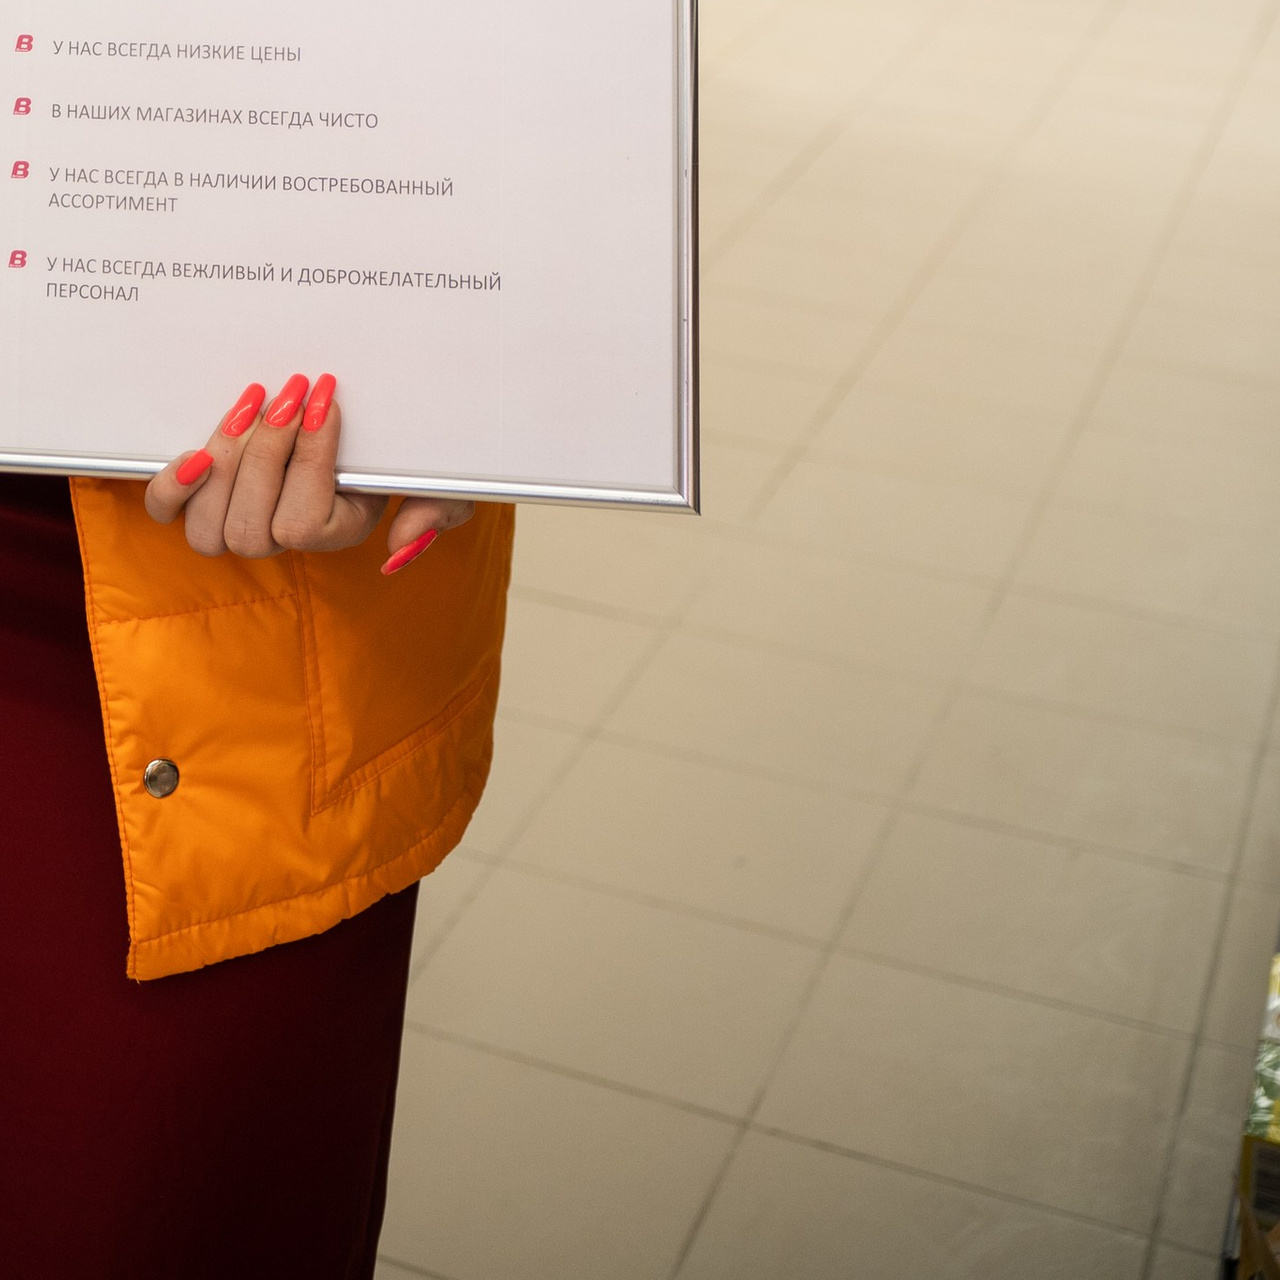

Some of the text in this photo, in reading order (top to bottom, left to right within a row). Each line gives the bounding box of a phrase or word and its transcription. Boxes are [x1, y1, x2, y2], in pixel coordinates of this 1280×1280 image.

[52, 40, 301, 64] У НАС ВСЕГДА НИЗКИЕ ЦЕНЫ
[51, 103, 379, 130] В НАШИХ МАГАЗИНАХ ВСЕГДА ЧИСТО
[49, 166, 453, 197] У НАС ВСЕГДА В НАЛИЧИИ ВОСТРЕБОВАННЫЙ
[48, 192, 179, 213] АССОРТИМЕНТ
[46, 256, 501, 291] У НАС ВСЕГДА ВЕЖЛИВЫЙ И ДОБРОЖЕЛАТЕЛЬНЫЙ
[46, 282, 139, 302] ПЕРСОНАЛ
